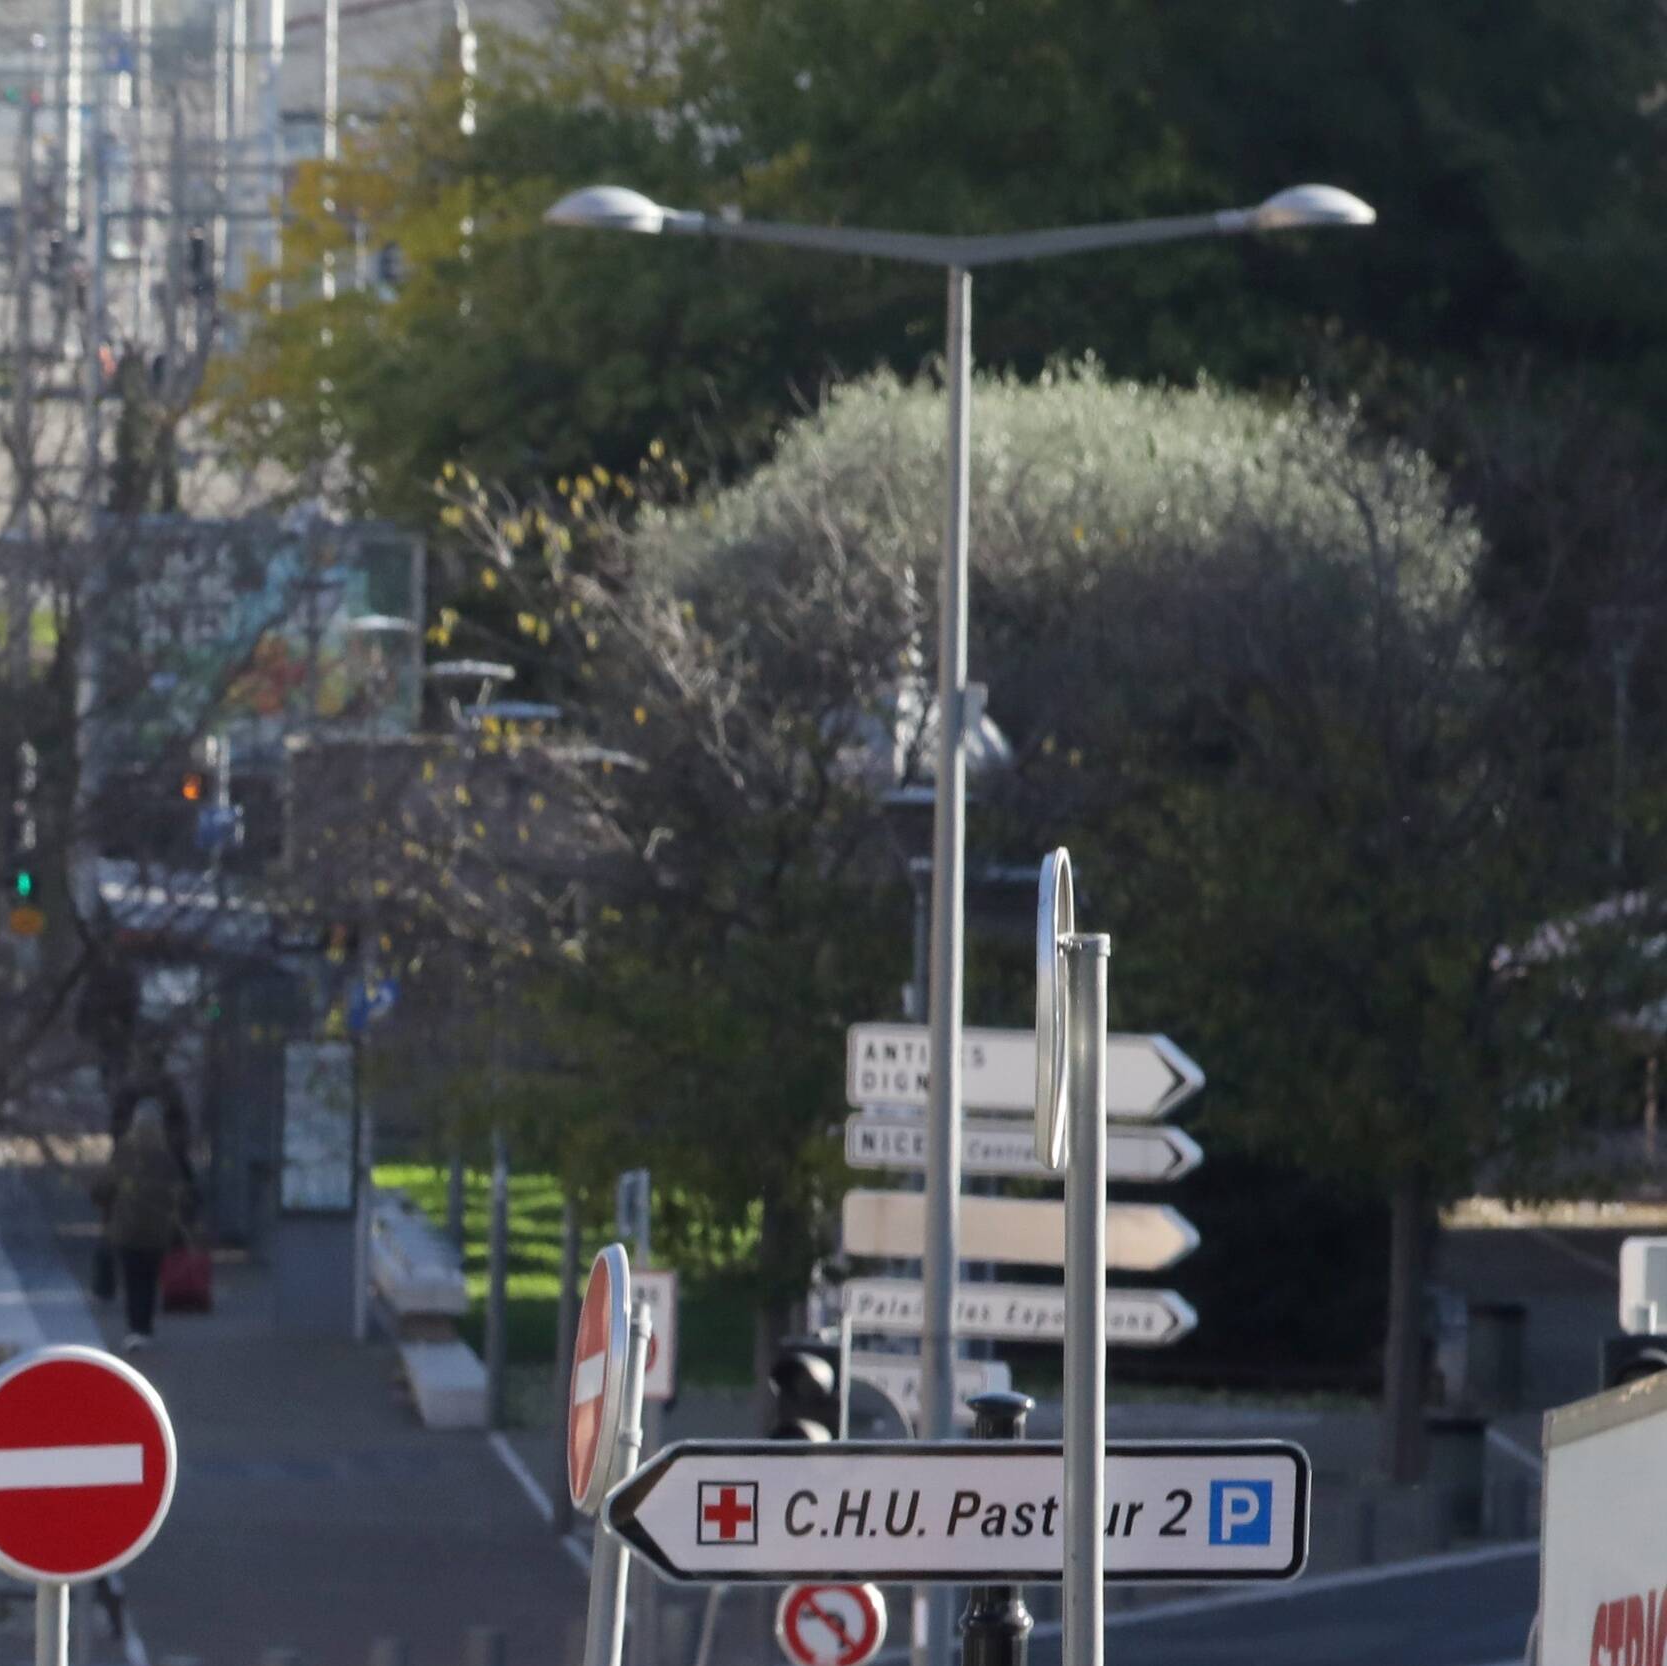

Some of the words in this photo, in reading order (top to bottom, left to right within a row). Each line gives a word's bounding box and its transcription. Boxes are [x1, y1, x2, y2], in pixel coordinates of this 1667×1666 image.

[865, 1041, 984, 1069] ANTIS
[862, 1072, 930, 1089] DIGN
[784, 1489, 926, 1537] C.H.U.
[946, 1490, 1143, 1537] Pastur
[1159, 1489, 1194, 1537] 2
[1220, 1487, 1260, 1542] P
